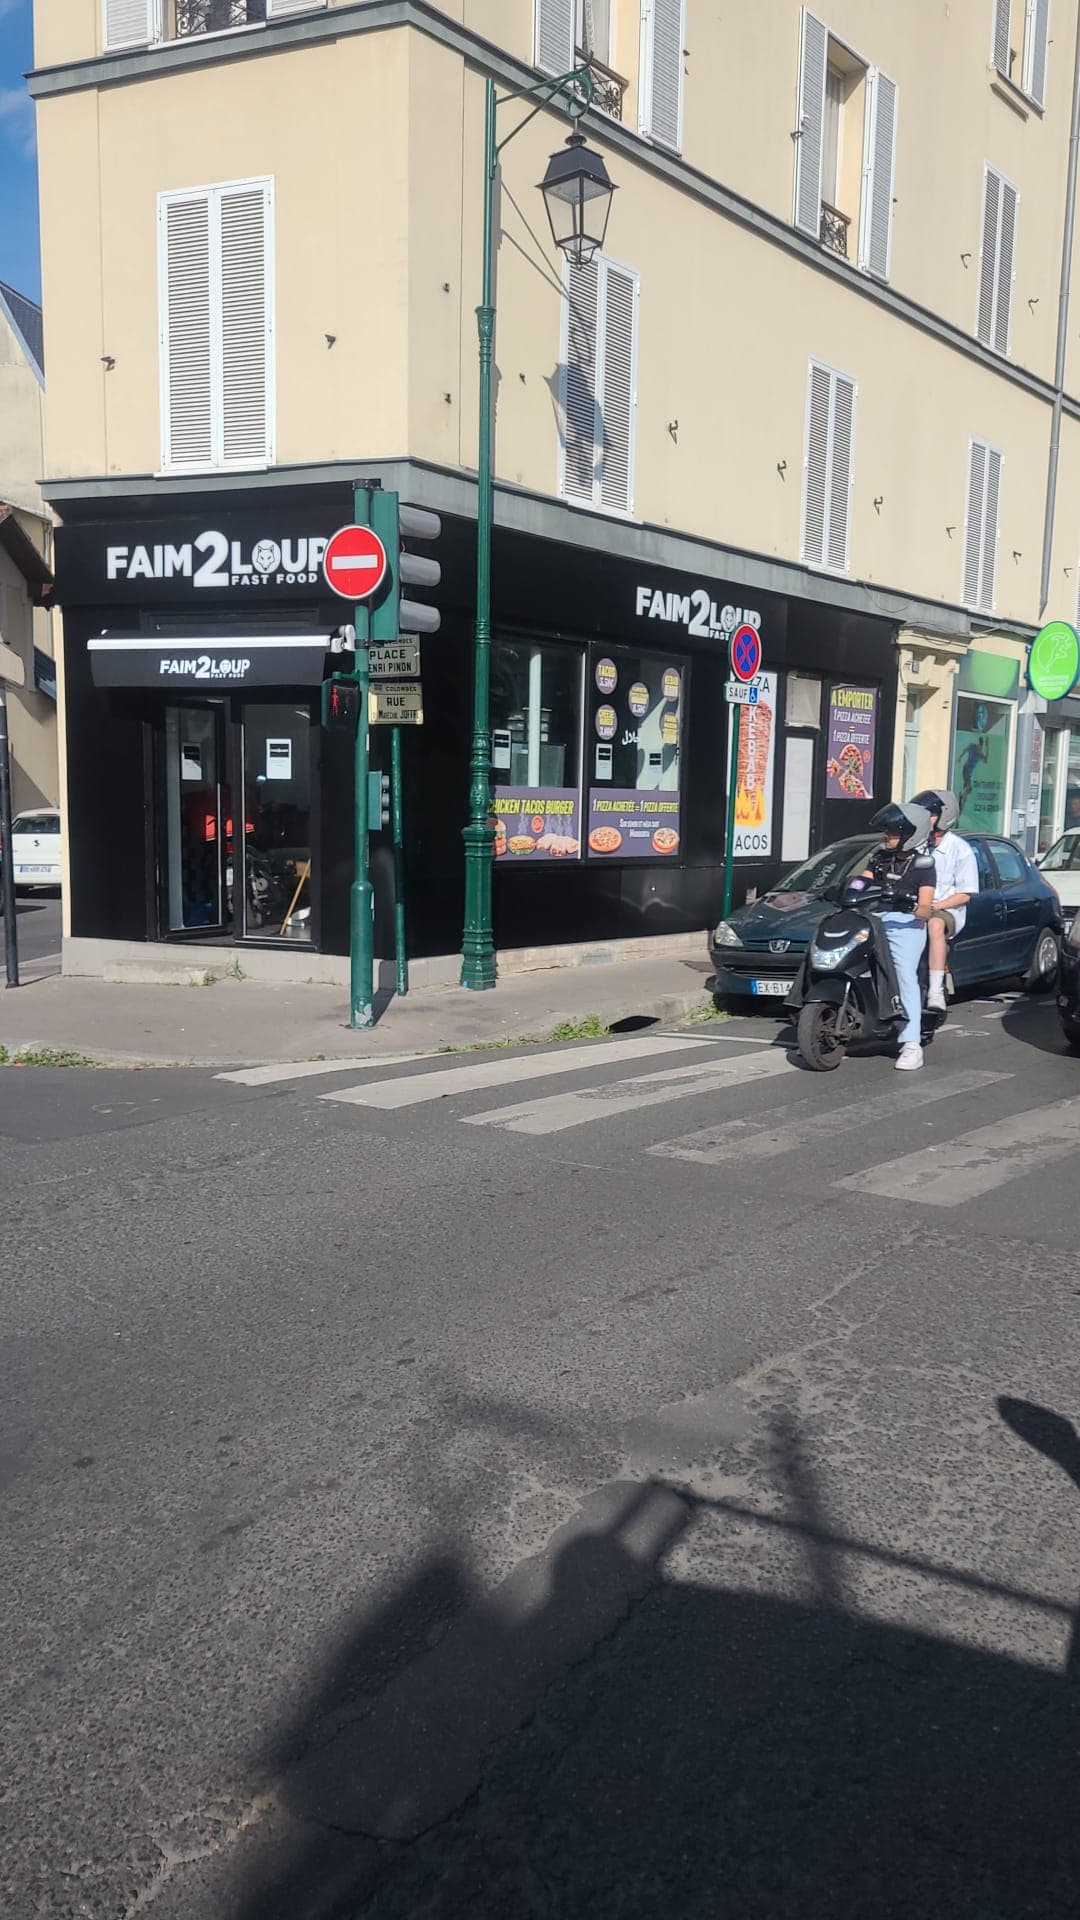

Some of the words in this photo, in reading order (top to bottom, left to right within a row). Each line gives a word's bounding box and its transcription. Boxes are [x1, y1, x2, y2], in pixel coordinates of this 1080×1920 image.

[231, 575, 269, 586] FAST
[276, 573, 318, 585] FOOD
[709, 629, 730, 641] FAST
[369, 649, 406, 660] PLACE
[369, 663, 386, 673] ENRI
[388, 662, 412, 672] PINON
[728, 686, 748, 699] SAUF
[386, 697, 406, 707] RUE
[837, 689, 874, 710] EMPORTER
[746, 705, 757, 790] KEBAB
[520, 799, 546, 814] TACOS
[545, 800, 575, 815] BURGER
[596, 800, 613, 812] PIZZA
[734, 834, 768, 850] ACOS
